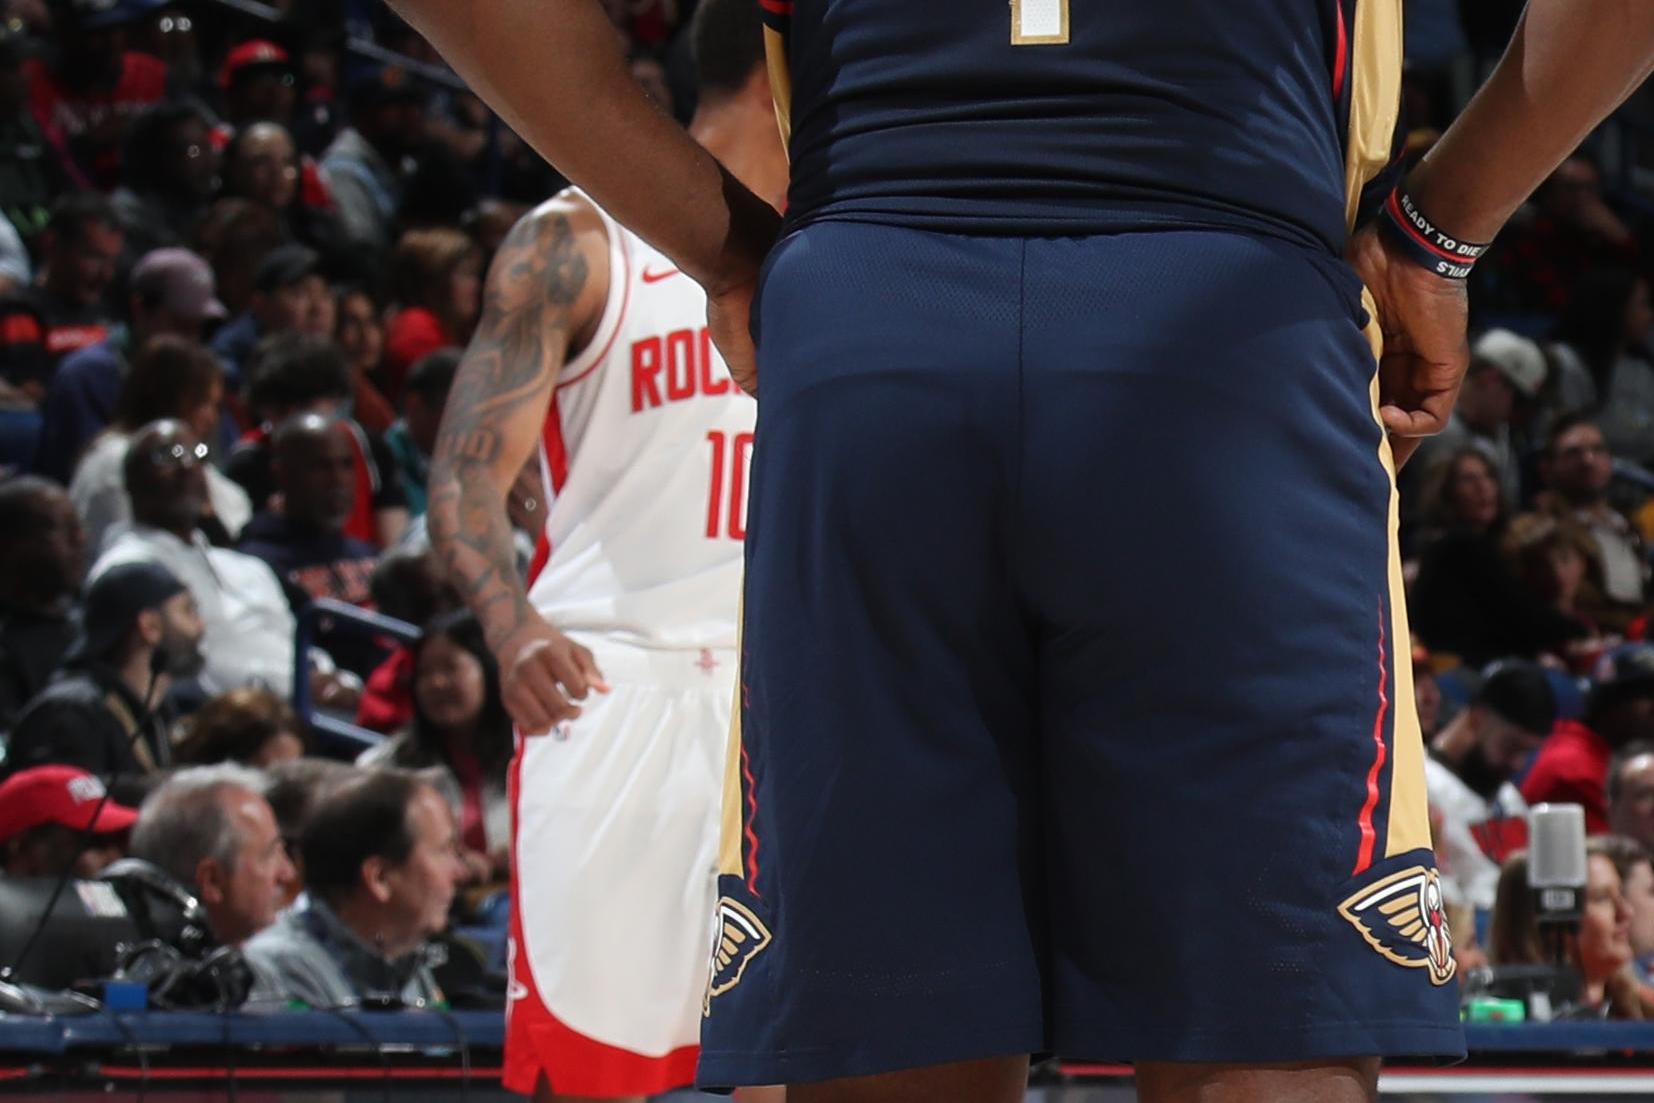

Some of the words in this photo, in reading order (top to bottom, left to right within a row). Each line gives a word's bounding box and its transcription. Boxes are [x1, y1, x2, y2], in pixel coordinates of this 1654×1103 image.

[1401, 194, 1435, 235] READY
[1436, 232, 1457, 250] TO
[1456, 244, 1481, 257] DIE
[632, 327, 742, 413] ROC
